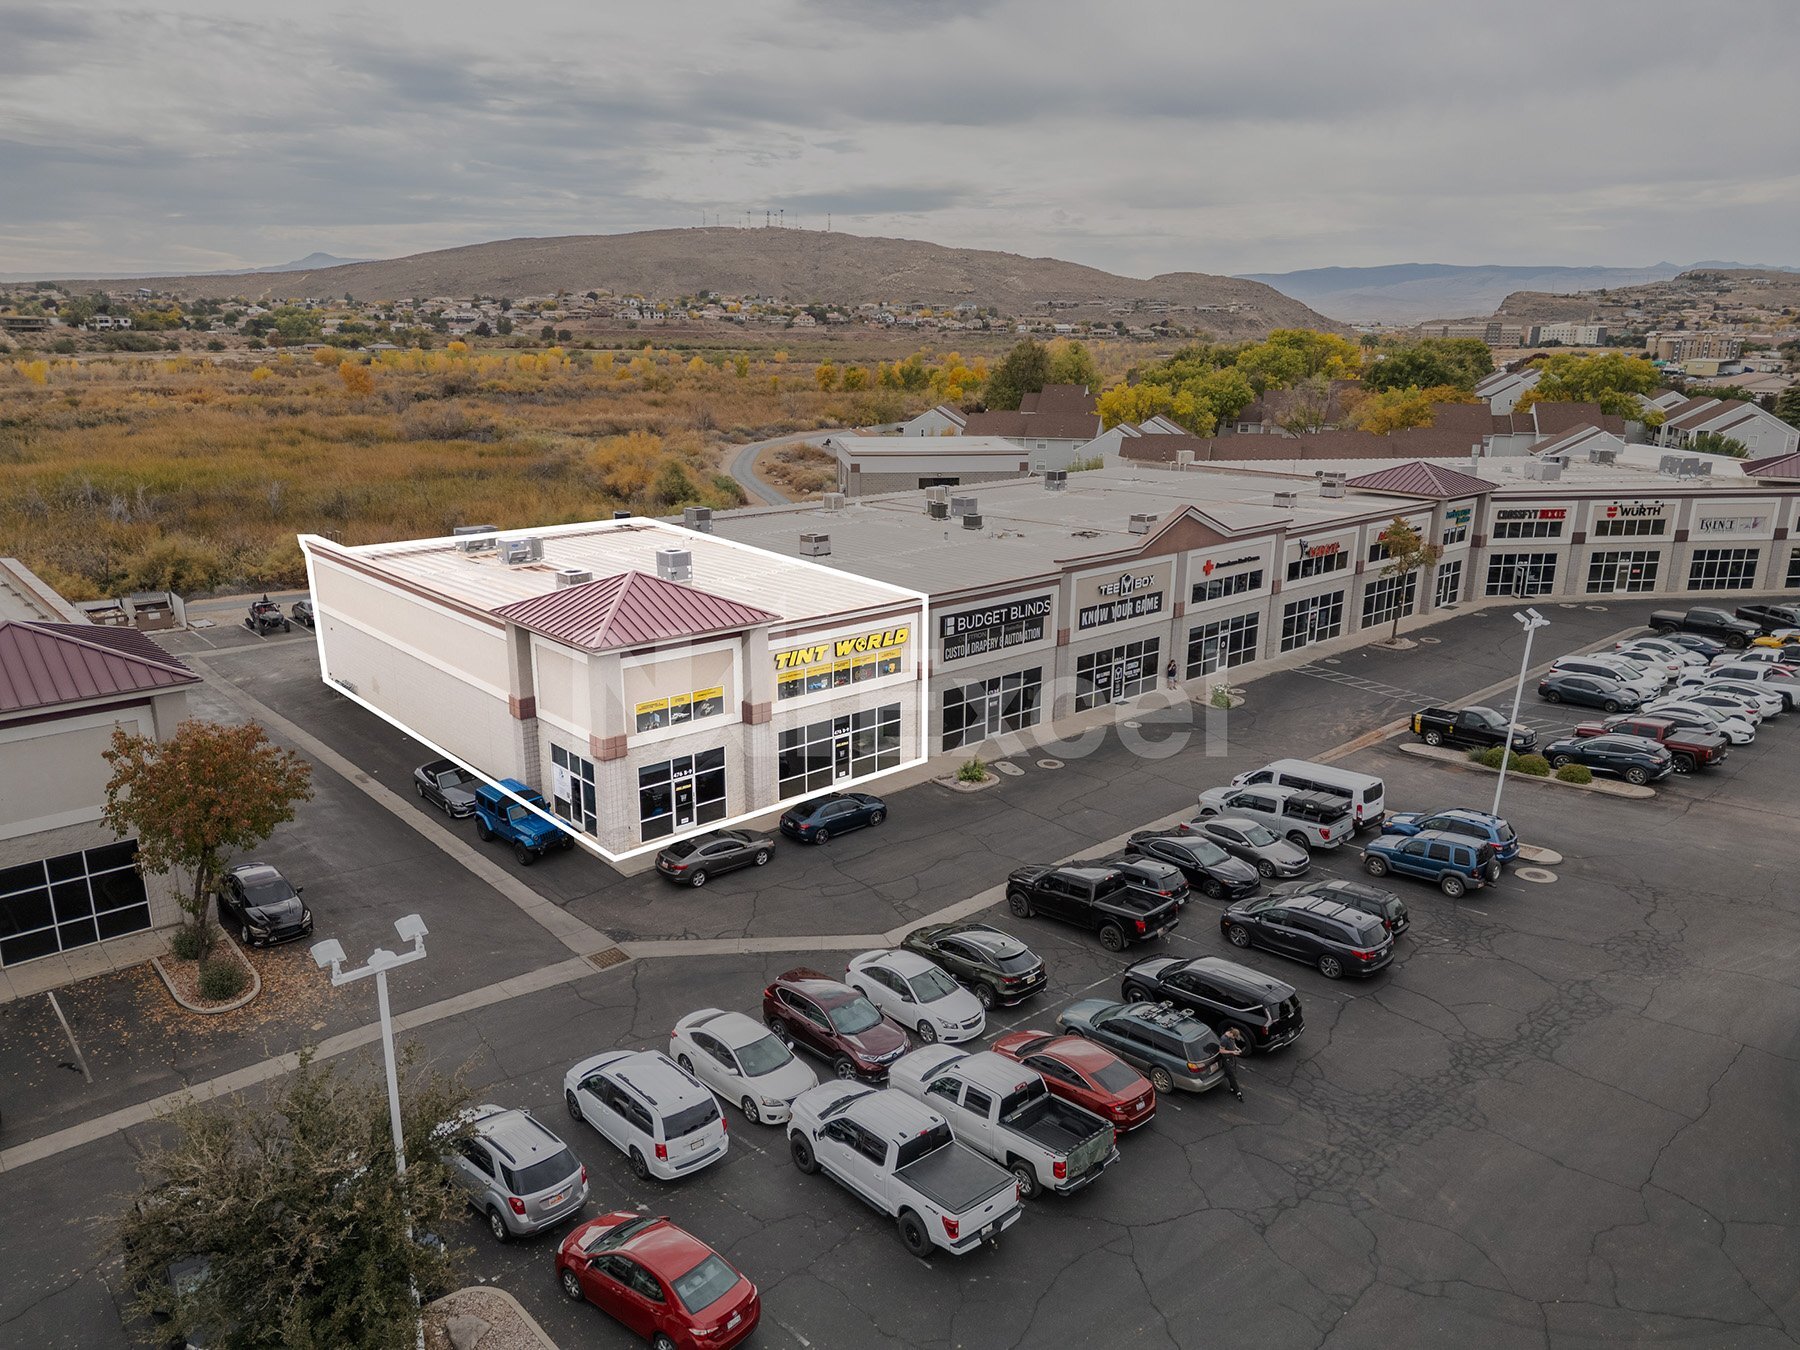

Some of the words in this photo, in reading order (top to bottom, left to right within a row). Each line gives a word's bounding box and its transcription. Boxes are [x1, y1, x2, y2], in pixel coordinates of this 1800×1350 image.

[1620, 506, 1661, 517] WÜRTH
[1099, 582, 1120, 596] TEE
[1134, 575, 1155, 589] BOX
[957, 608, 1008, 631] BUDGET
[1010, 599, 1051, 620] BLINDS
[1081, 607, 1109, 626] KNOW
[1111, 602, 1133, 619] YOUR
[1135, 596, 1159, 612] GAME
[775, 644, 829, 670] TINT
[834, 627, 909, 657] WORLD
